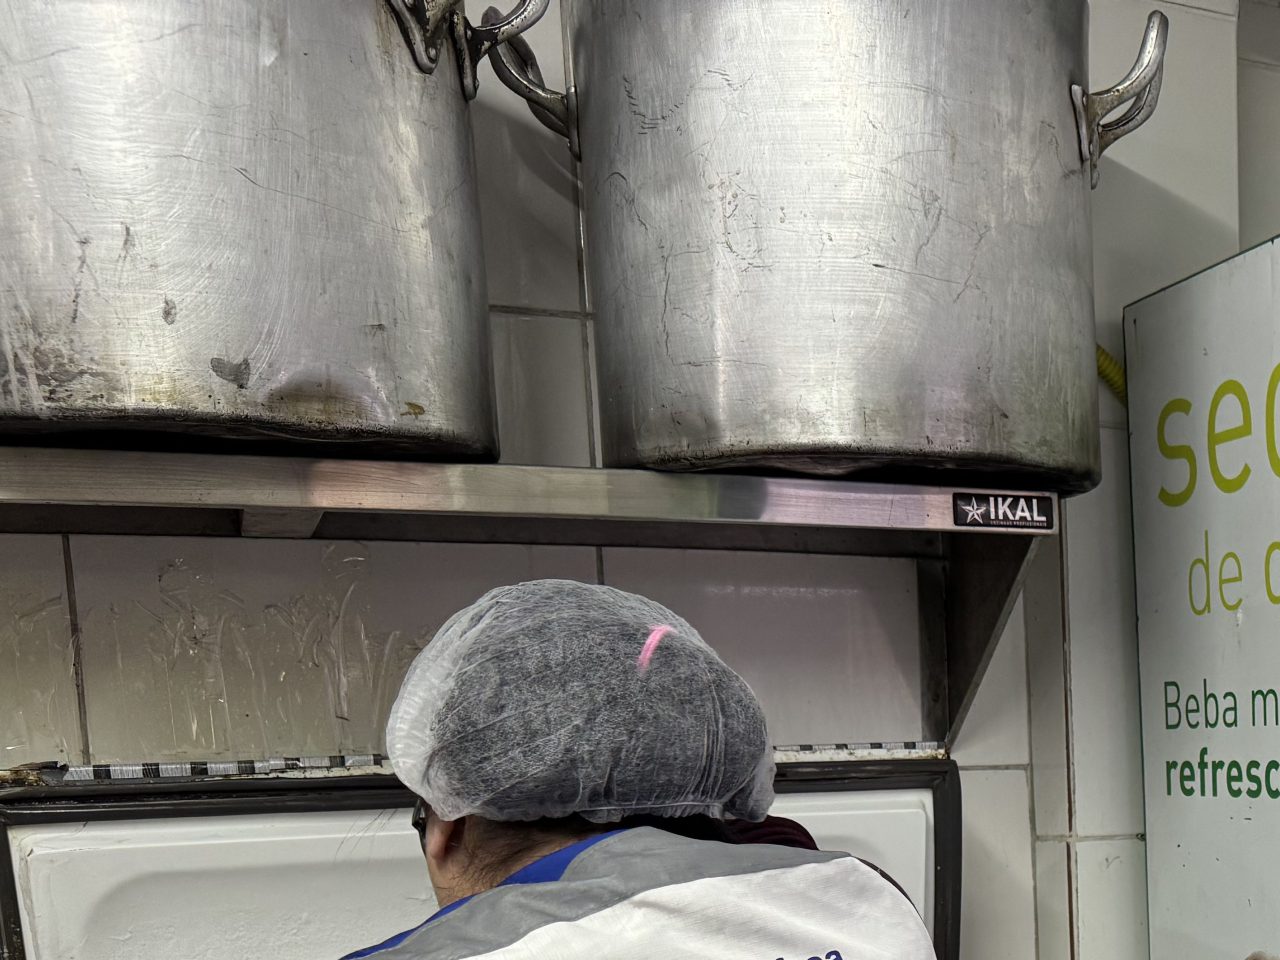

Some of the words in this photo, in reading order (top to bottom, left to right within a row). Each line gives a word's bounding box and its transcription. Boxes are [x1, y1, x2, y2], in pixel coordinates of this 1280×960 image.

[989, 496, 1047, 522] IKAL
[1188, 529, 1243, 616] de
[1164, 678, 1238, 729] Beba
